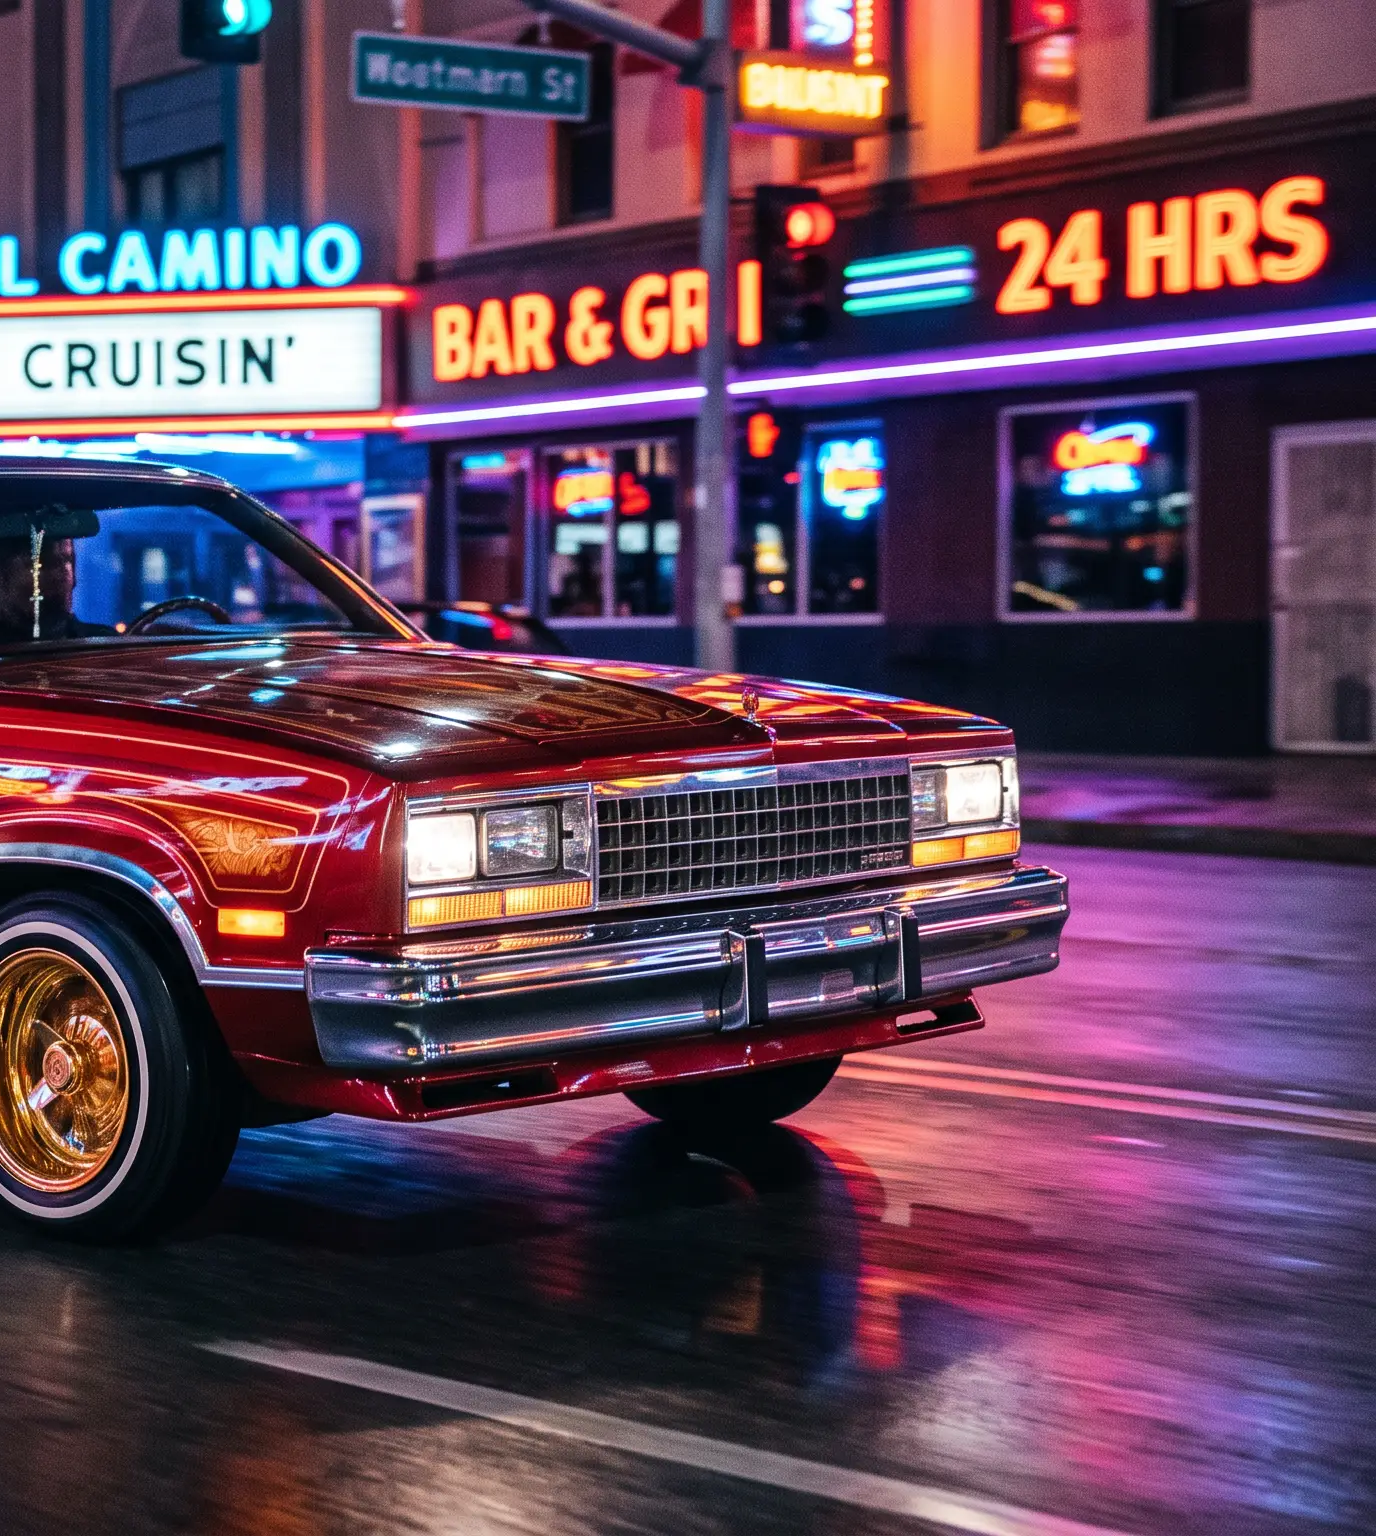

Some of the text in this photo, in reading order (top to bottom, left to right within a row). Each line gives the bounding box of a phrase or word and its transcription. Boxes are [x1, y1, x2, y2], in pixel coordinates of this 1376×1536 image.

[543, 66, 575, 101] St
[58, 223, 363, 292] CAMINO
[996, 176, 1328, 313] 24 HRS
[23, 336, 294, 389] CRUISIN'
[432, 292, 556, 382] BAR
[564, 286, 614, 366] &
